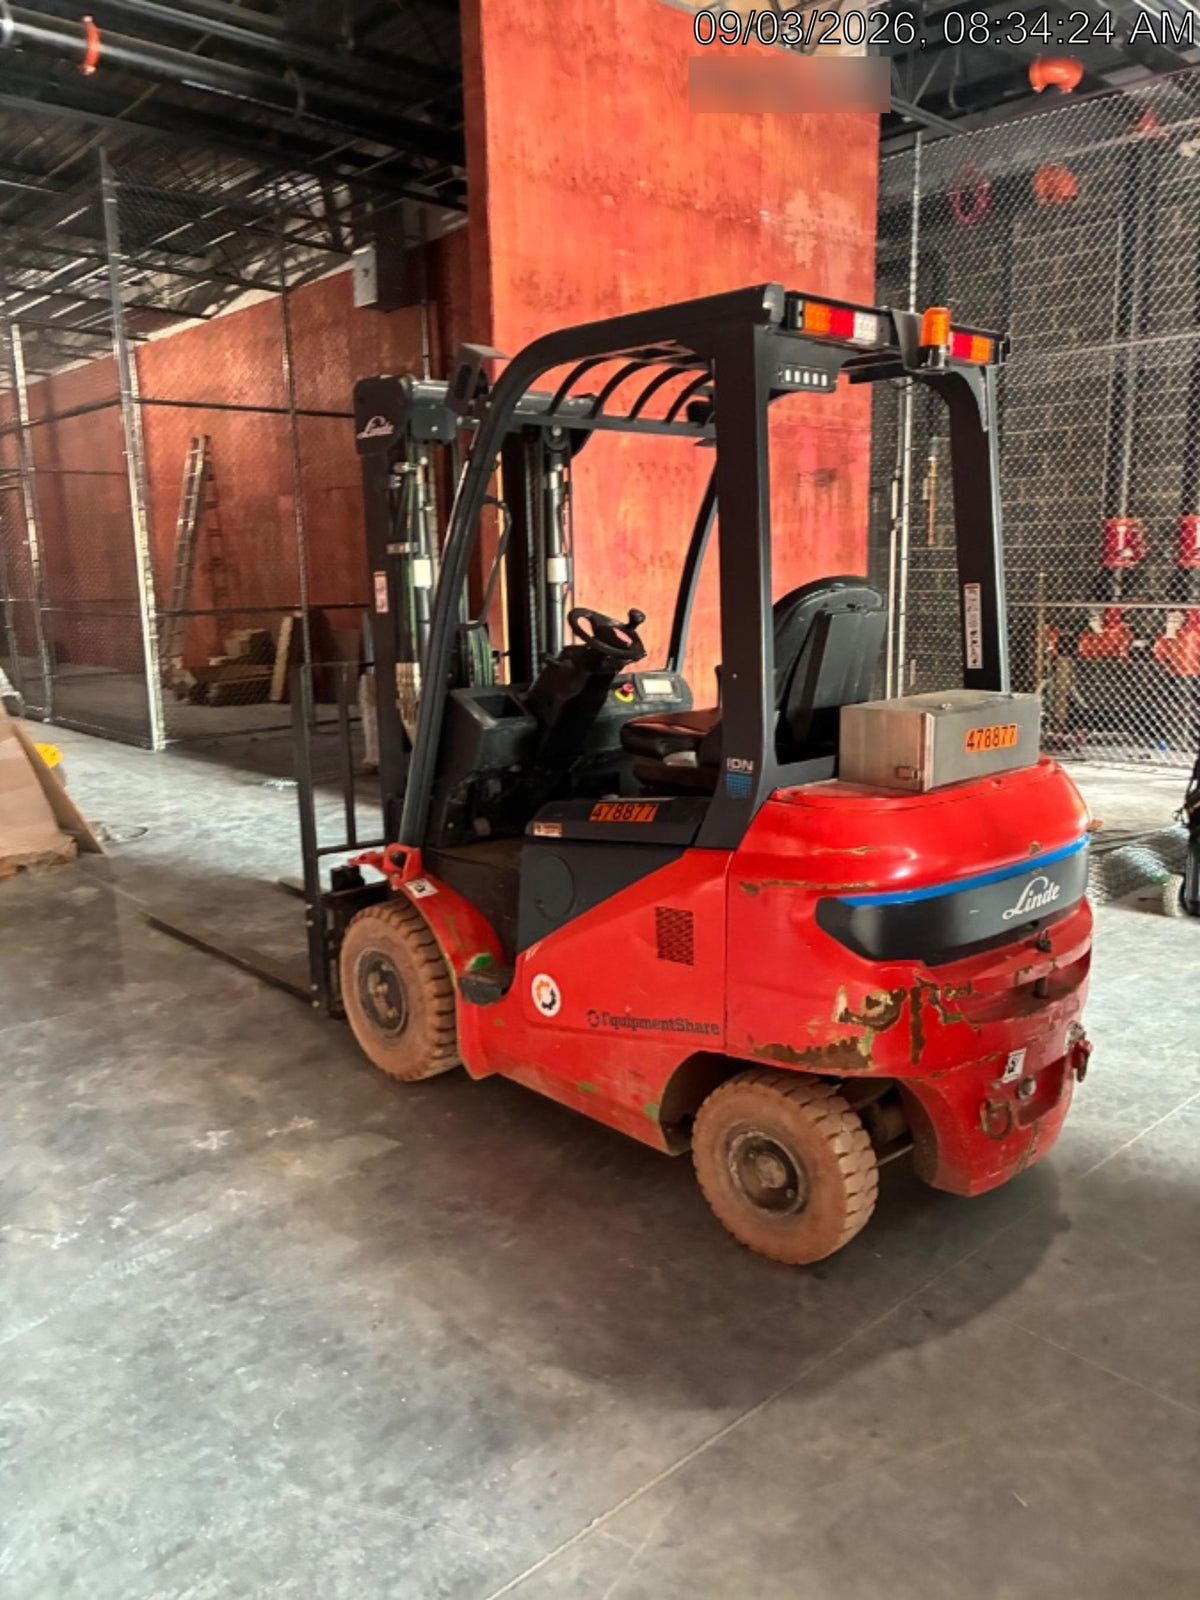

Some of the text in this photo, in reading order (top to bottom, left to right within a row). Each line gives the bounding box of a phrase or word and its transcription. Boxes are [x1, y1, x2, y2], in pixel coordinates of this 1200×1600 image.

[966, 724, 1017, 751] 478877
[592, 802, 657, 821] 478877
[1002, 875, 1061, 920] Linde
[600, 1010, 721, 1036] EquipmentShare
